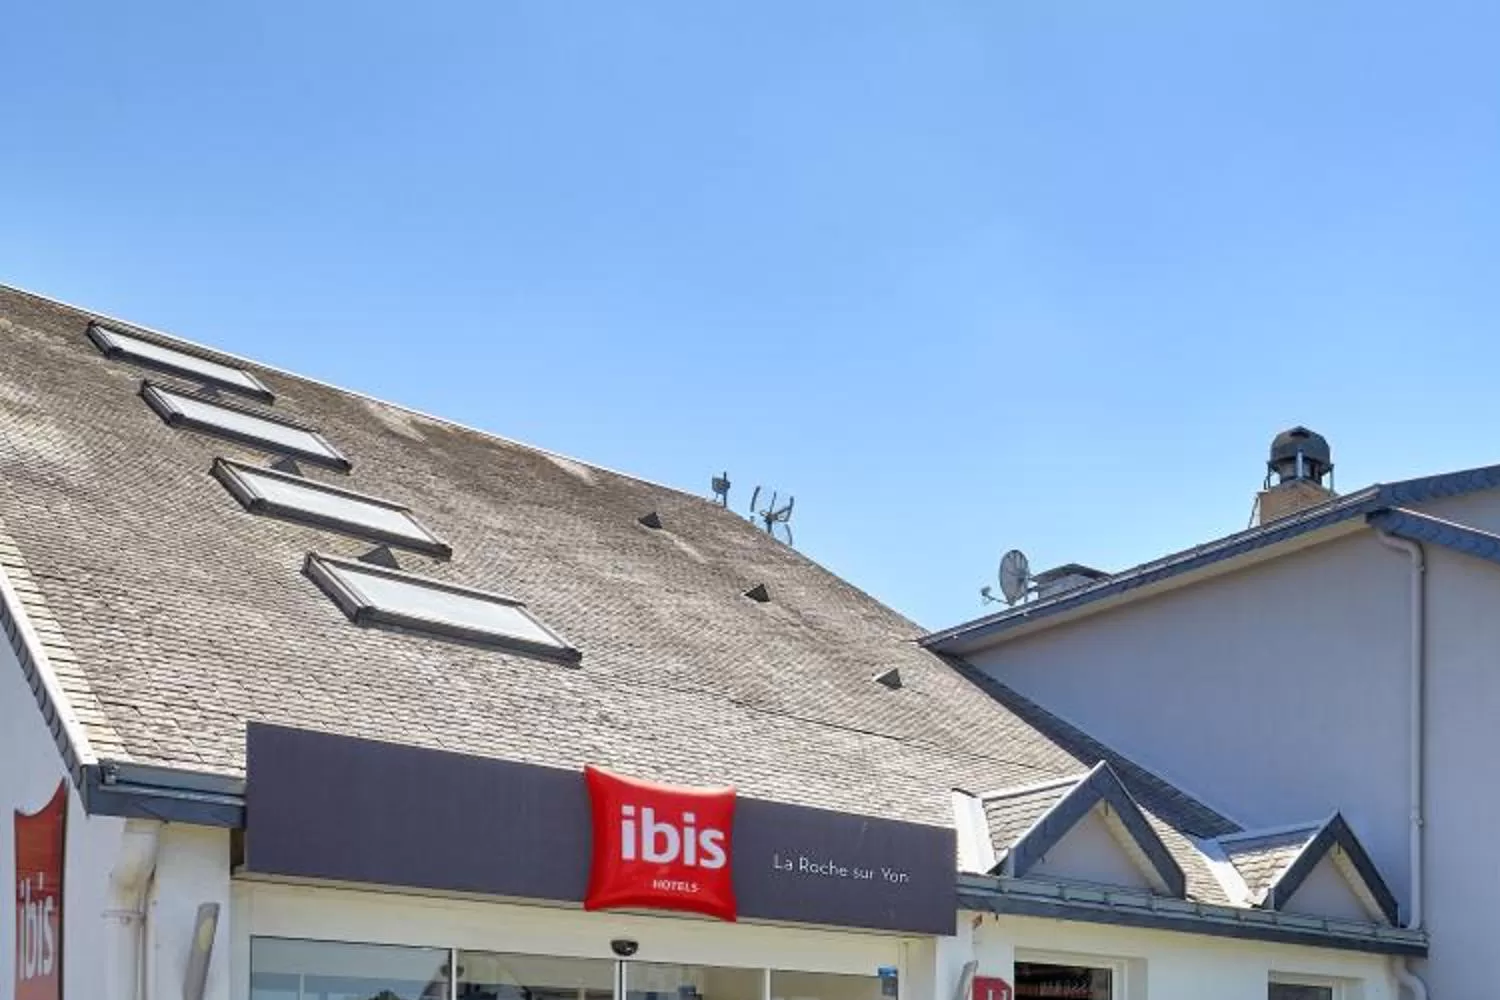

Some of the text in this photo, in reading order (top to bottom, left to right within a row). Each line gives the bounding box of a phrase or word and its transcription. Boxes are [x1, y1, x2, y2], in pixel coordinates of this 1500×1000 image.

[621, 804, 727, 869] ibis
[653, 879, 699, 893] HOTELS
[774, 853, 793, 871] La
[799, 856, 849, 877] Roche
[853, 867, 873, 880] sur
[19, 872, 53, 981] ibis
